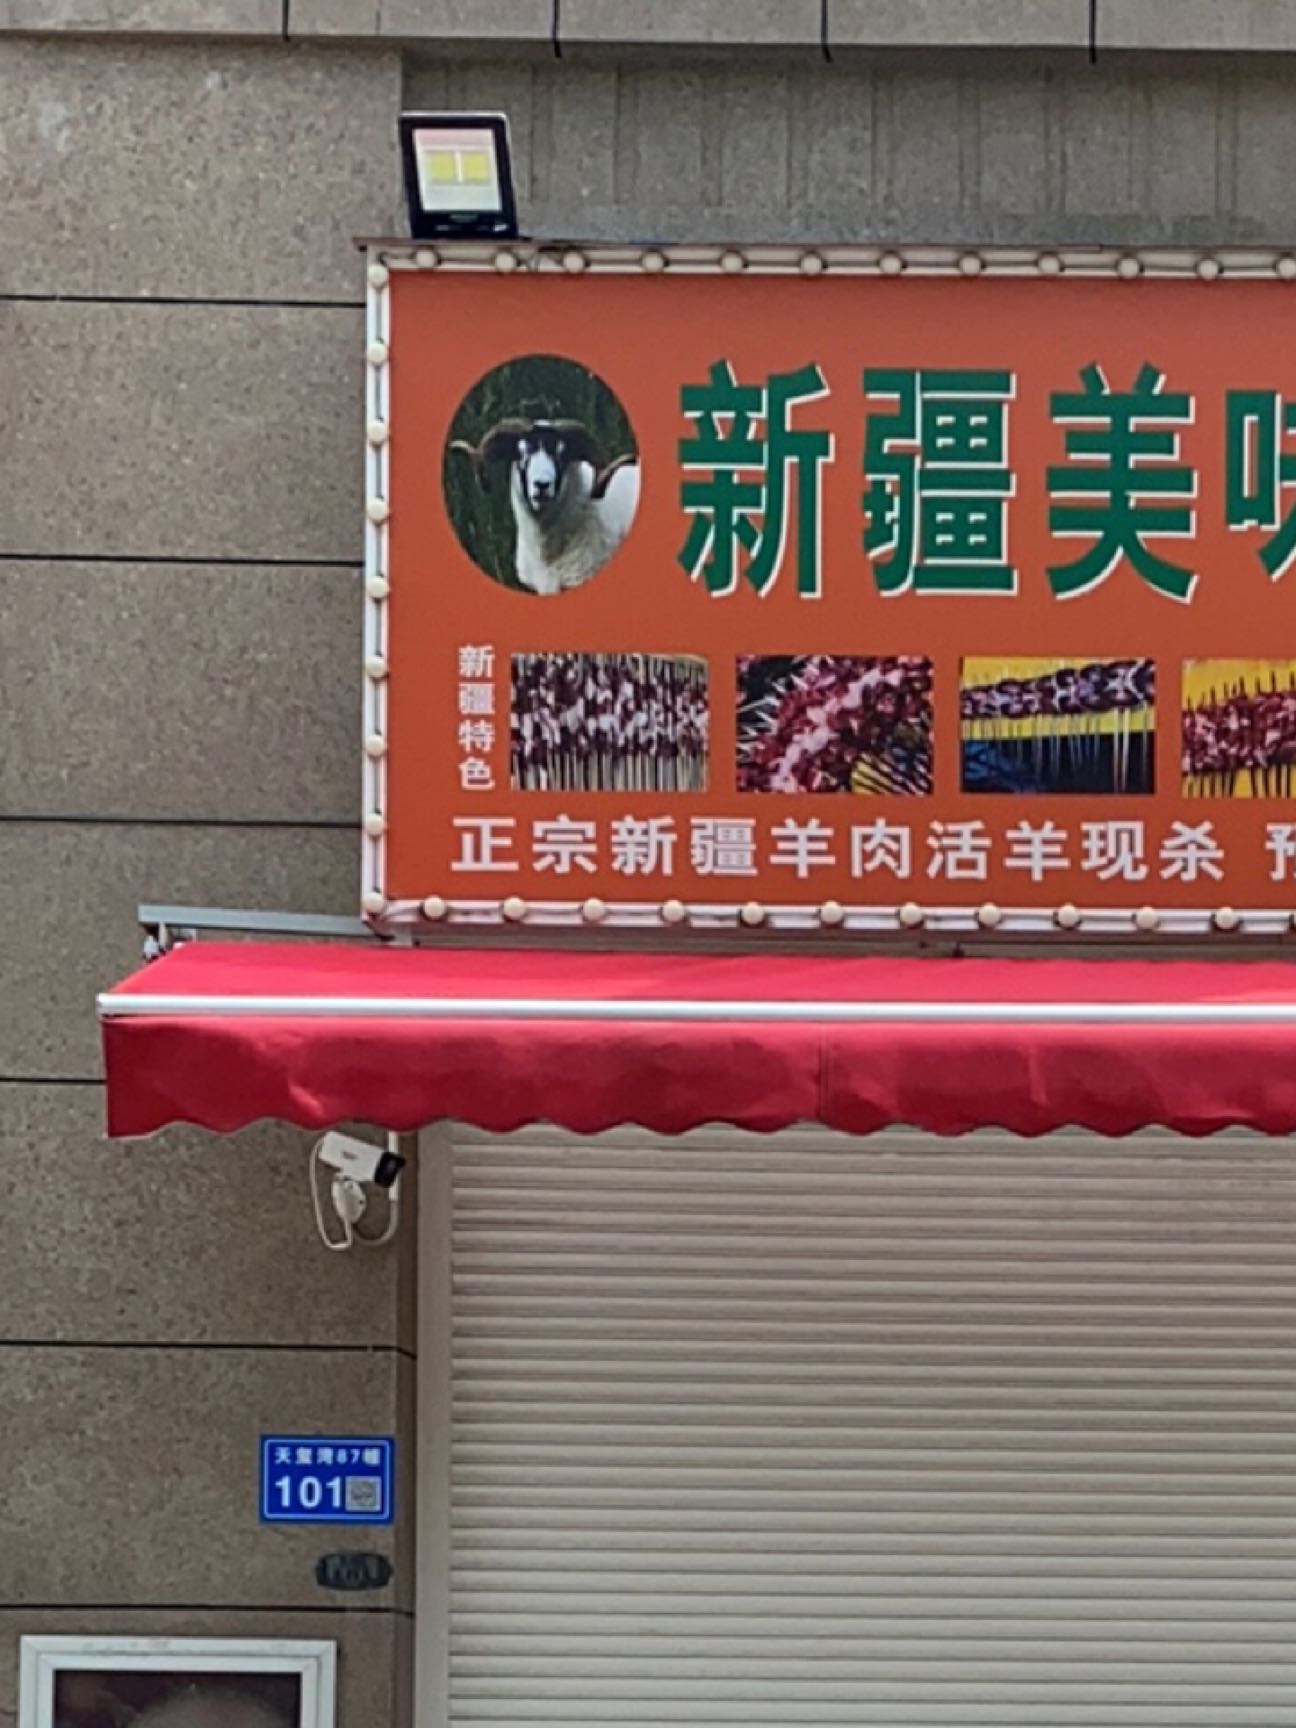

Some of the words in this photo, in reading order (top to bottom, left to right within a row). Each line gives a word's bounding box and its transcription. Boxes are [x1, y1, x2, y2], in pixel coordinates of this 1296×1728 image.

[458, 643, 496, 792] 新疆特色
[451, 814, 1226, 883] 正宗新疆羊肉活羊现杀
[274, 1475, 342, 1509] 101
